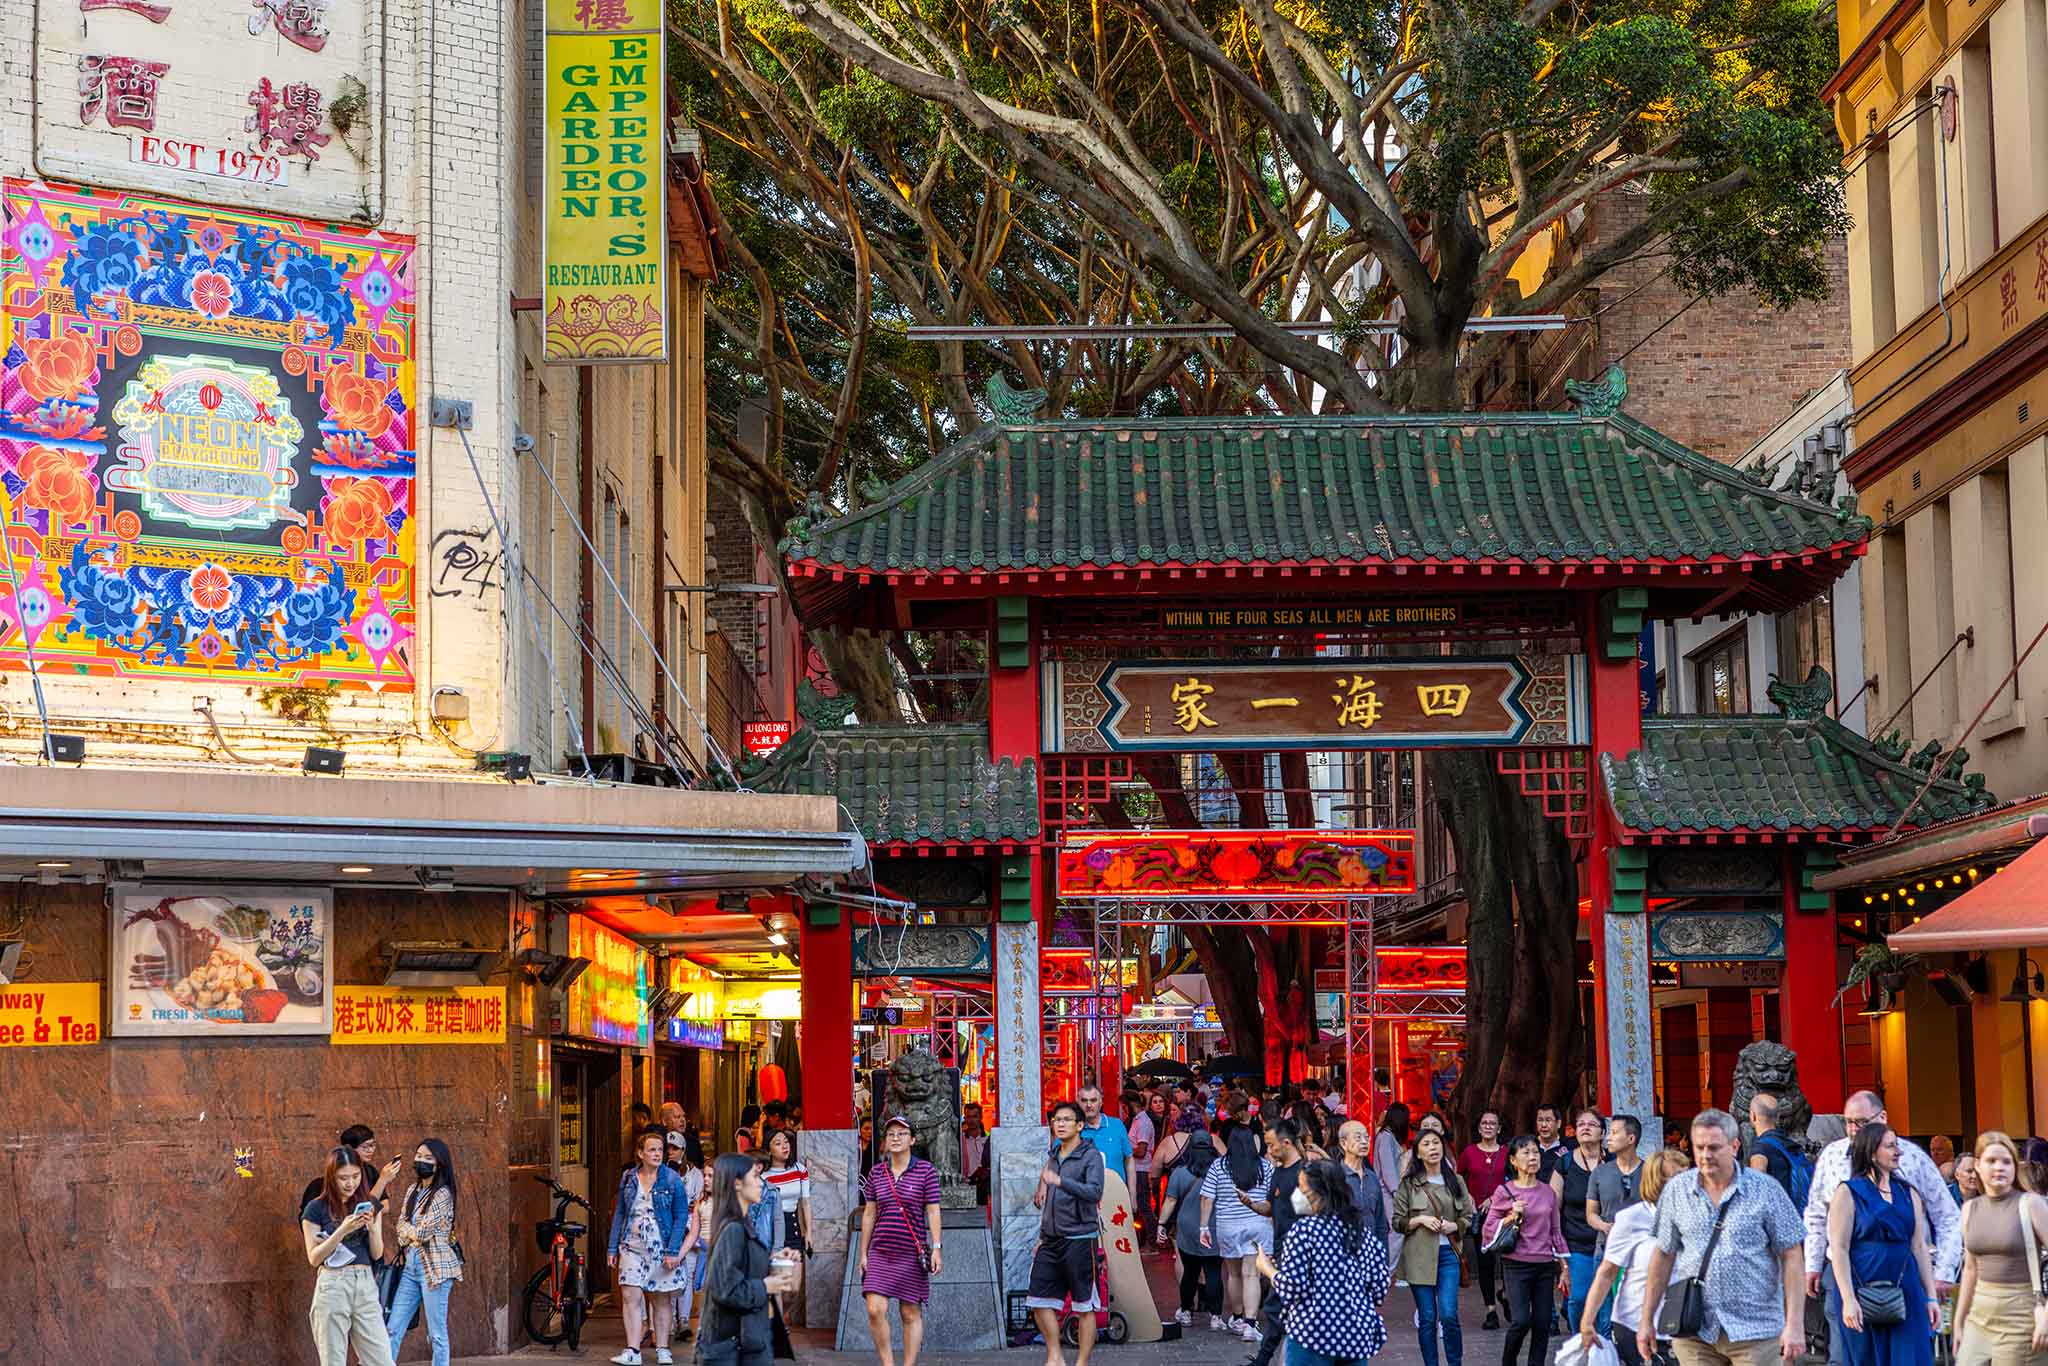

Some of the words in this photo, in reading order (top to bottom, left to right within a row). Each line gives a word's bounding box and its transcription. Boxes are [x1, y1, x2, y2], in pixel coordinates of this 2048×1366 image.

[560, 64, 601, 219] GARDEN
[608, 38, 648, 257] EMPEROR'S
[141, 136, 206, 171] EST
[216, 149, 283, 183] 1979
[549, 263, 658, 287] RESTAURANT
[160, 413, 260, 452] NEON
[160, 444, 260, 470] PLAYGROUND
[1166, 611, 1203, 625] WITHIN
[1208, 611, 1231, 625] THE
[1236, 611, 1267, 625] FOUR
[1273, 610, 1303, 624] SEAS
[1309, 609, 1332, 624] ALL
[1337, 609, 1361, 623] MEN
[1367, 608, 1391, 623] ARE
[1396, 607, 1456, 622] BROTHERS
[0, 992, 46, 1015] way
[152, 1008, 188, 1020] FRESH
[34, 1016, 51, 1043] &
[58, 1016, 97, 1042] Tea
